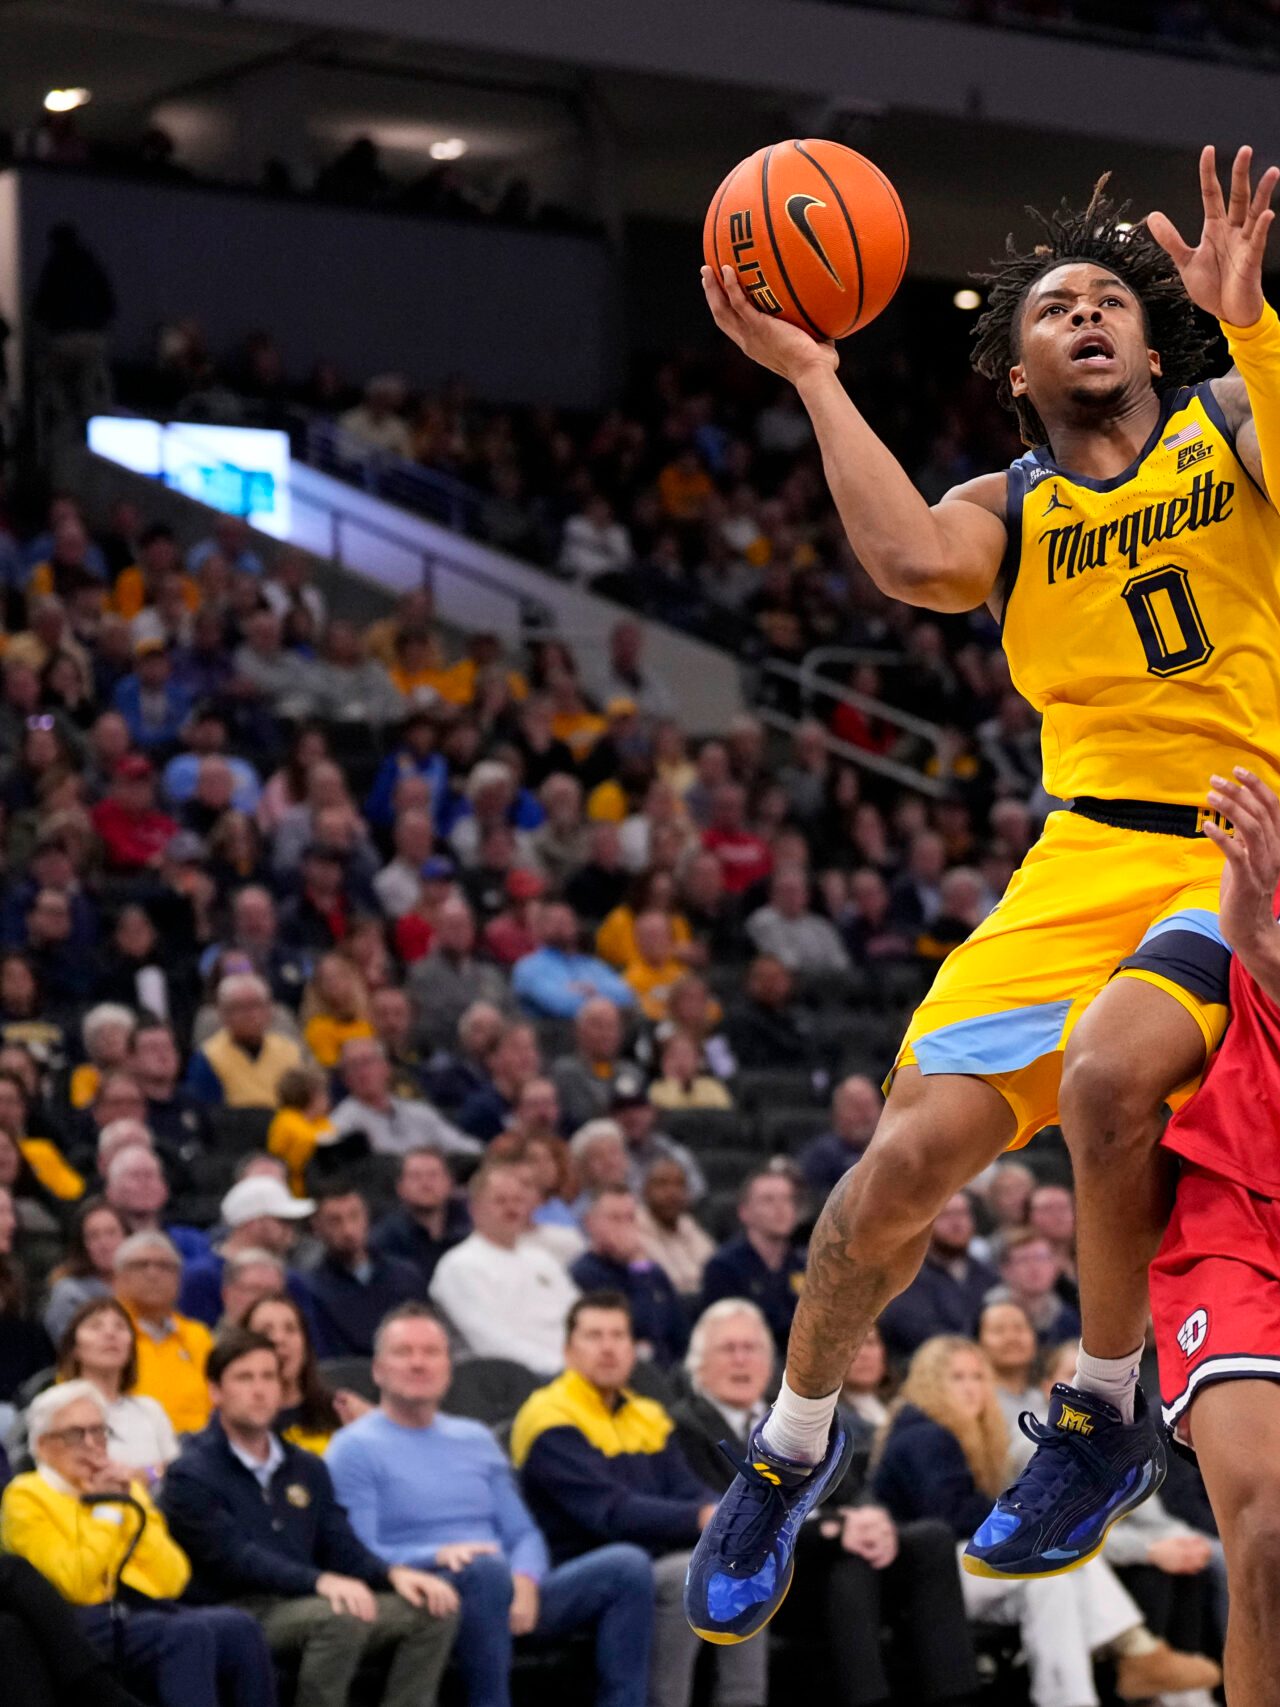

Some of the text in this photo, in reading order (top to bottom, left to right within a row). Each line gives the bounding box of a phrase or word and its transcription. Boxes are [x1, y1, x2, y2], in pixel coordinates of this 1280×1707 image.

[729, 209, 784, 315] ELITE
[1177, 444, 1213, 470] EAST
[1178, 440, 1203, 460] BIG
[1038, 469, 1235, 585] Marquette
[1120, 563, 1215, 679] 0
